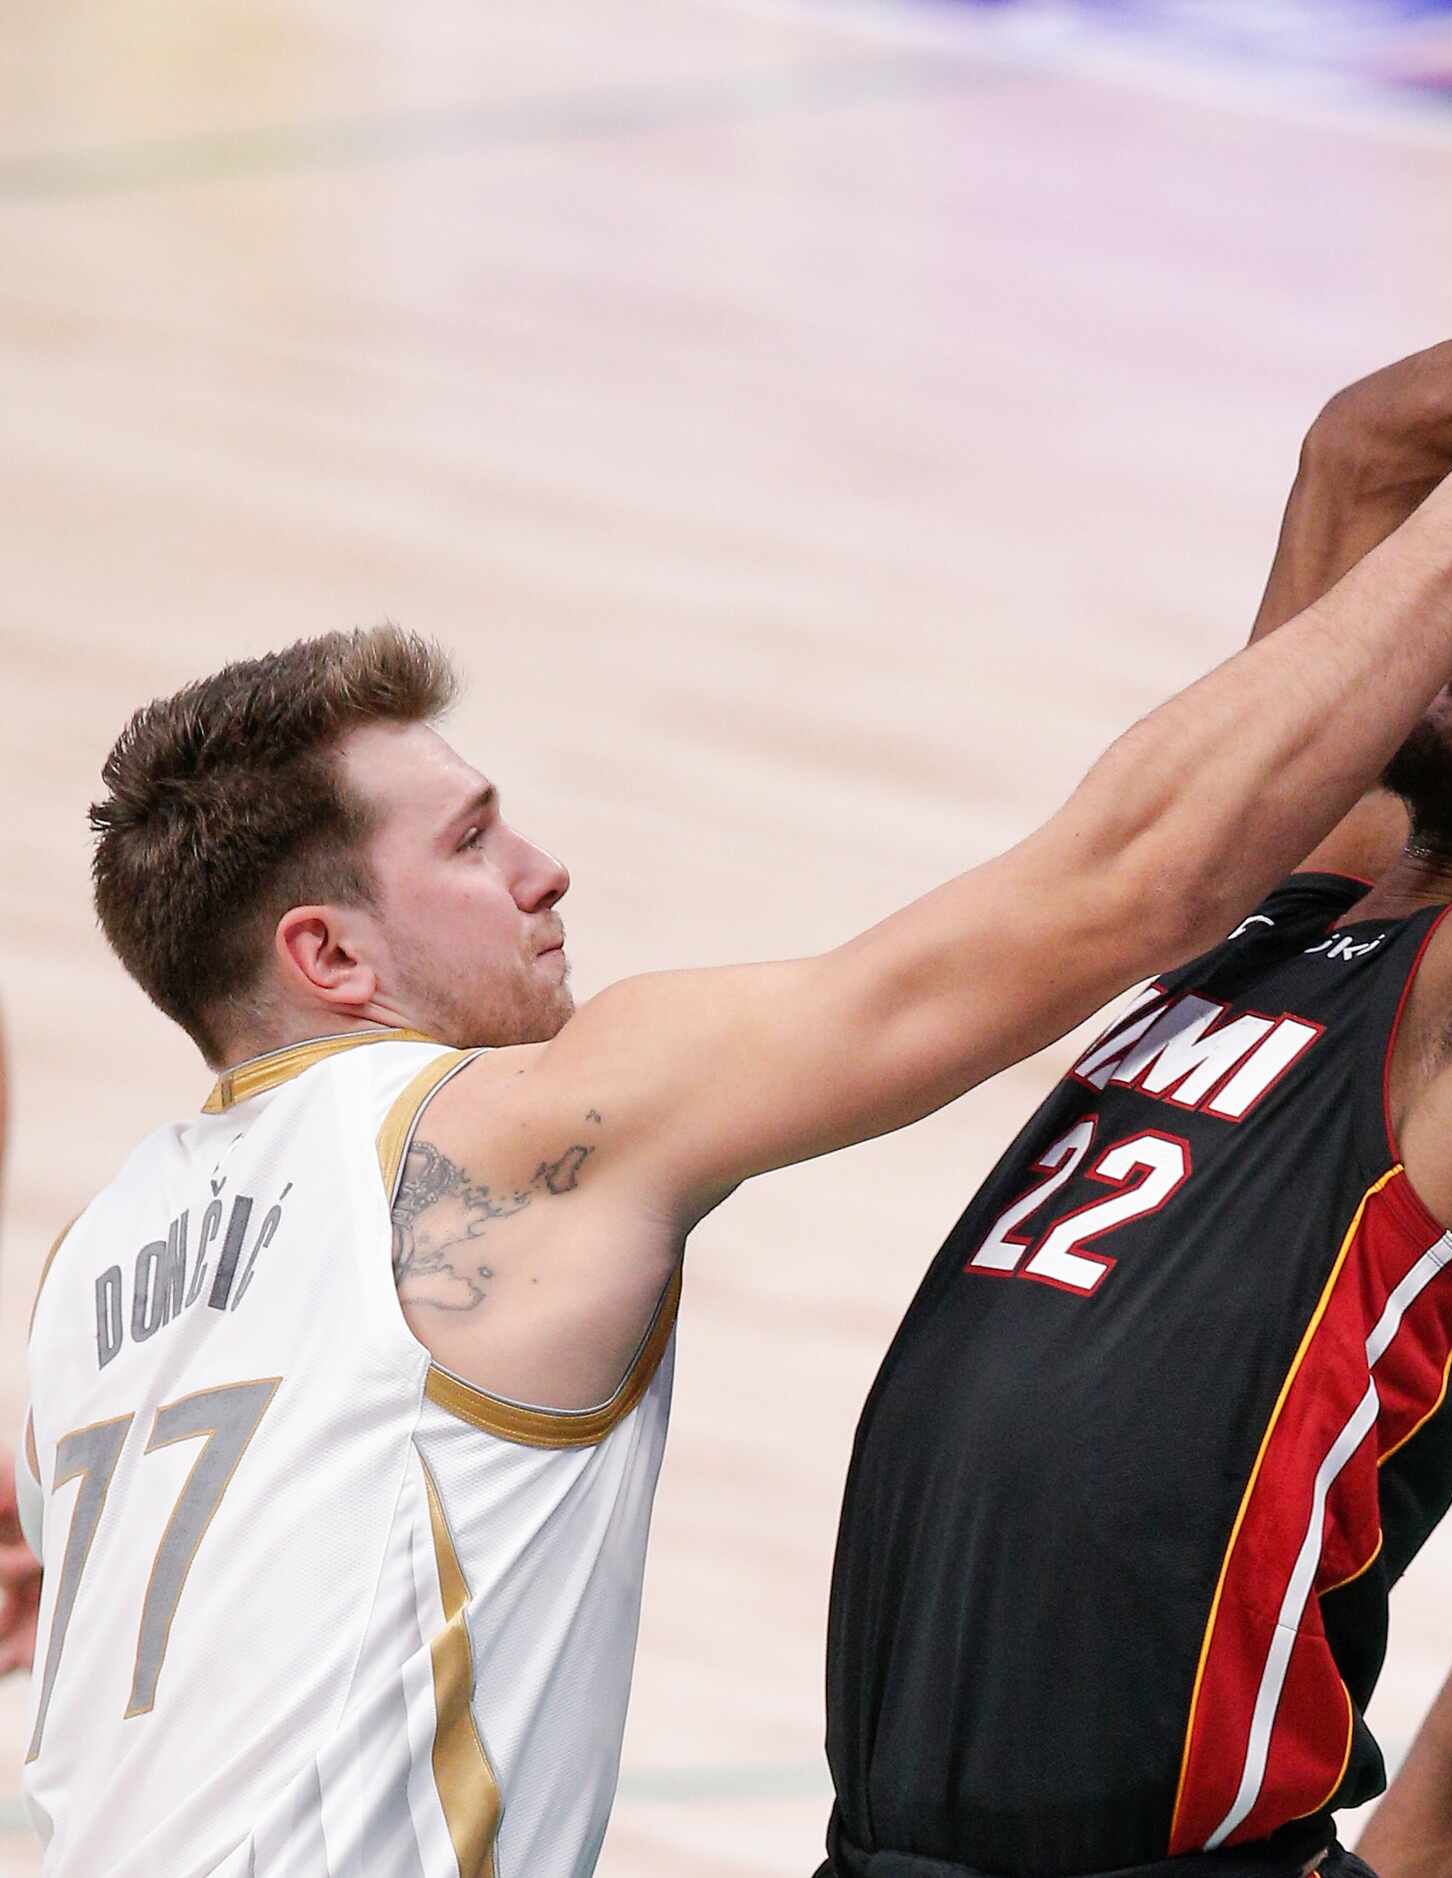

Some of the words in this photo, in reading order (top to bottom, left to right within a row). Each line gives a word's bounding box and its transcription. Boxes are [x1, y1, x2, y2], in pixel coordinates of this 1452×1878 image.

[95, 1175, 294, 1371] DONČIĆ
[964, 1112, 1192, 1298] 22
[24, 1376, 284, 1765] 77
